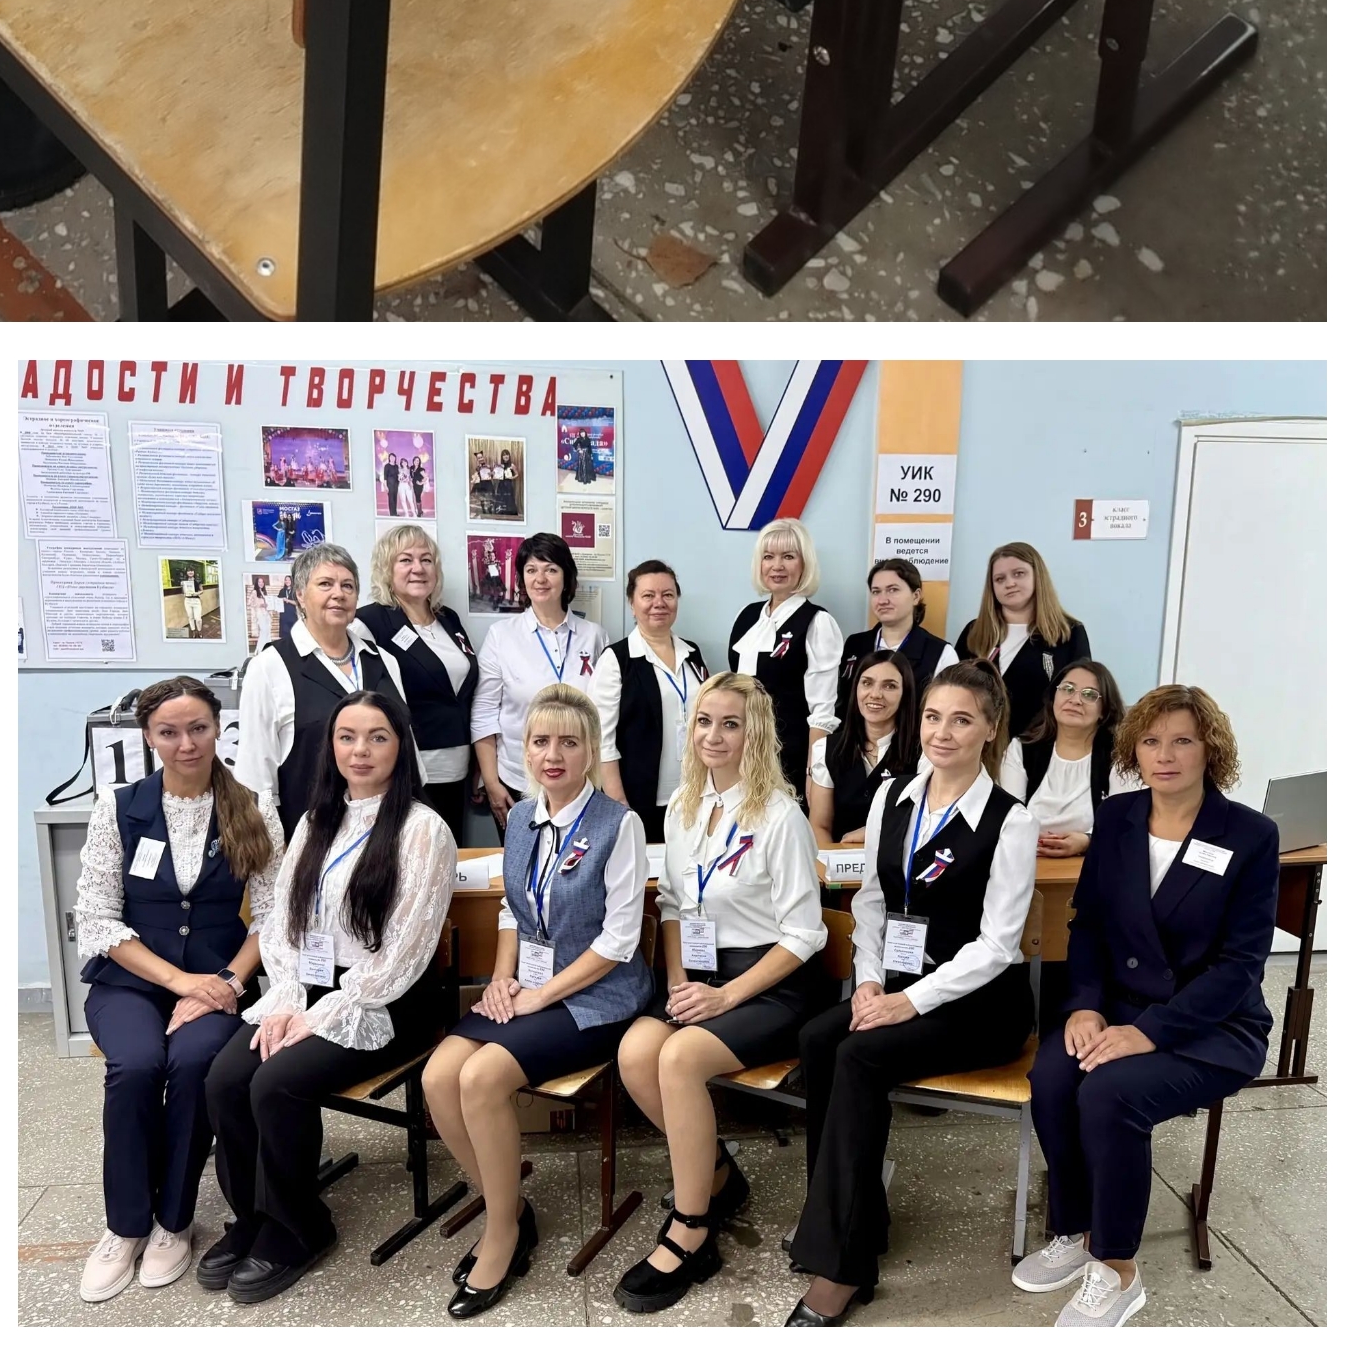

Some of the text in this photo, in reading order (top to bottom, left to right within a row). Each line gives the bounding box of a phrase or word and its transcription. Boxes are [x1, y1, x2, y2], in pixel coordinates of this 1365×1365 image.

[20, 360, 557, 417] АДОСТИ И ТВОРЧЕСТВА
[900, 465, 934, 480] УИК
[890, 488, 941, 503] № 290
[1079, 512, 1087, 527] 3
[106, 739, 133, 784] 1
